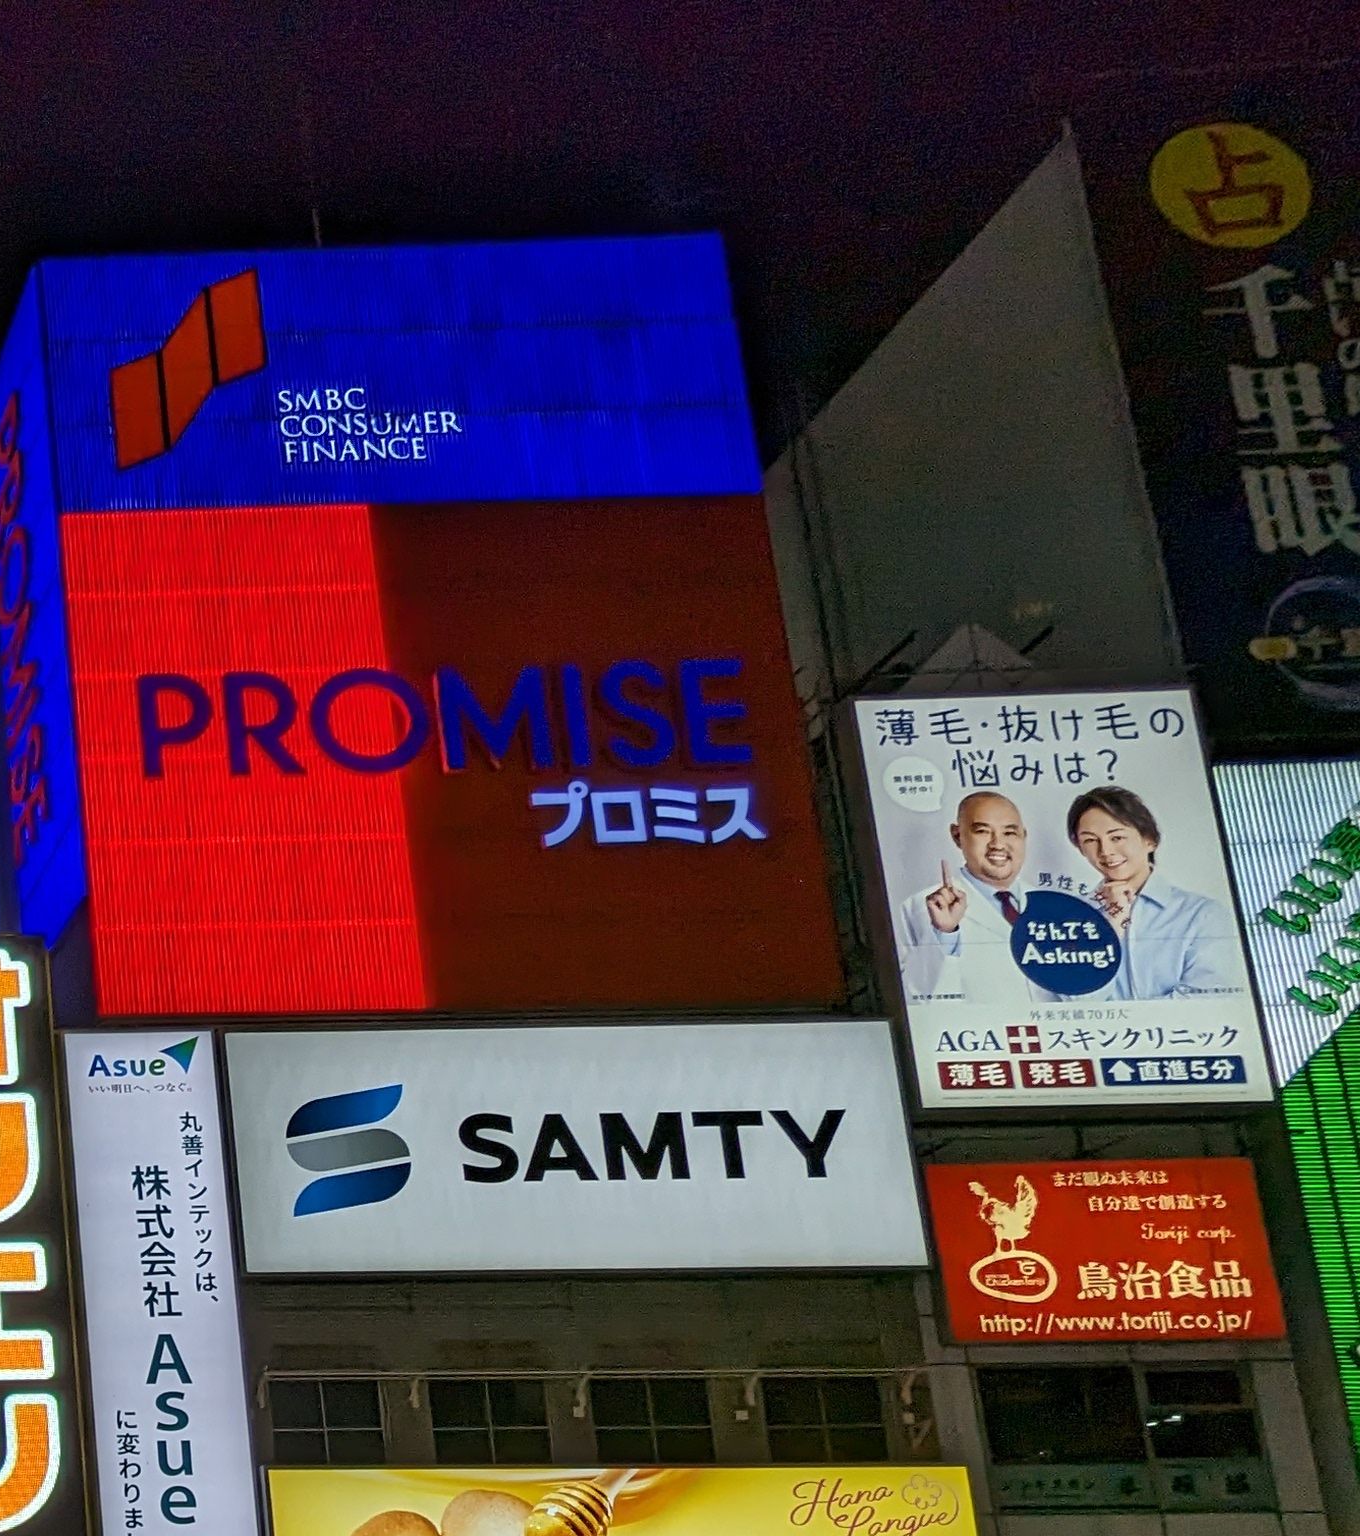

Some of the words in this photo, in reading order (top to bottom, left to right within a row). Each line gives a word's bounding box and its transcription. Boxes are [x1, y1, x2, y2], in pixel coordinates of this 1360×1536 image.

[278, 387, 366, 413] SMBC
[280, 411, 463, 438] CONSUMER
[284, 436, 429, 464] FINANCE
[135, 656, 754, 779] PROMISE
[531, 780, 768, 849] プロミス
[1021, 944, 1116, 968] Asking!
[937, 1030, 1004, 1052] AGA
[1048, 1025, 1239, 1050] スキンクリニック
[88, 1054, 166, 1078] Asue
[948, 1063, 1007, 1087] 薄毛
[1029, 1061, 1086, 1085] 発毛
[1137, 1060, 1234, 1081] 直進5分
[458, 1109, 846, 1184] SAMTY
[179, 1111, 218, 1303] 丸善インテックは、
[131, 1165, 182, 1318] 株式会社
[1077, 1260, 1253, 1300] 鳥治食品
[980, 1310, 1252, 1335] http://www.toriji.co.jp/
[146, 1333, 197, 1525] Asue
[790, 1478, 893, 1526] Hana
